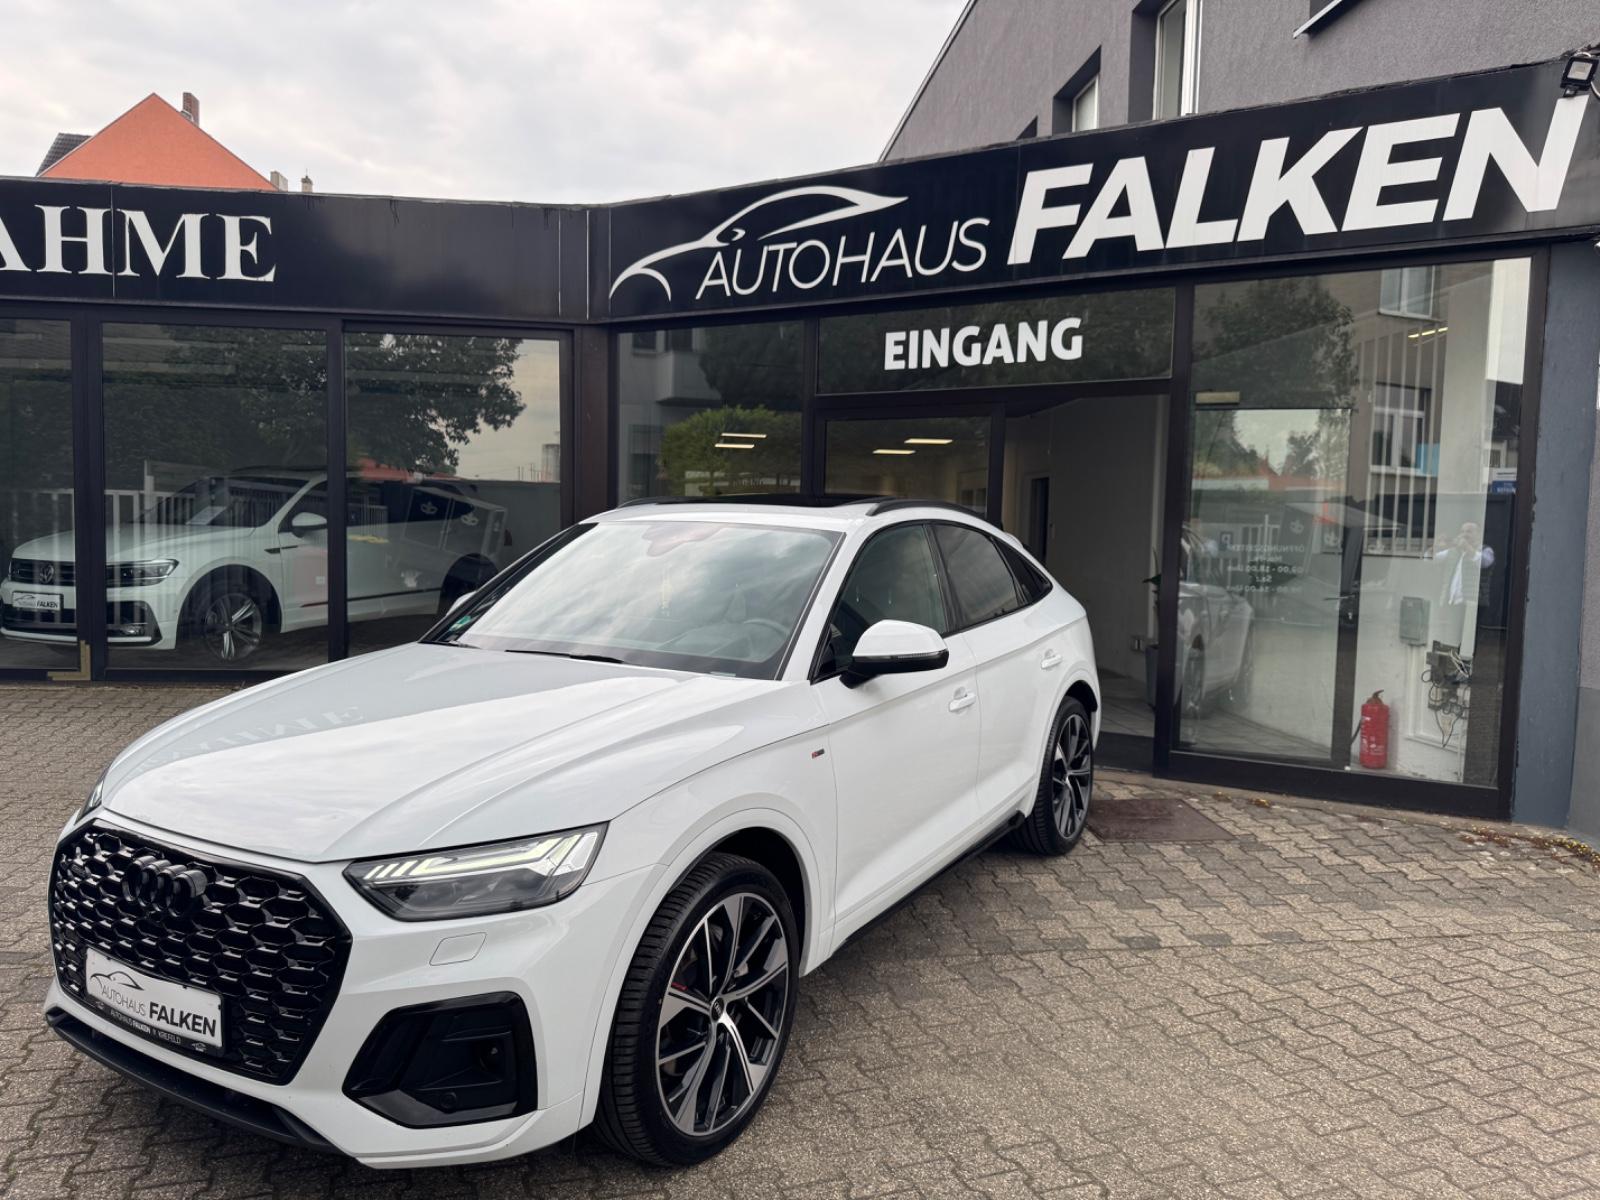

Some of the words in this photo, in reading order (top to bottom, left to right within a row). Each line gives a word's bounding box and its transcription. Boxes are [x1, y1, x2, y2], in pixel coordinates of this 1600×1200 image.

[695, 217, 990, 300] AUTOHAUS
[1007, 95, 1589, 265] FALKEN
[884, 317, 1083, 370] EINGANG
[101, 984, 146, 1017] AUTOHAUS
[149, 1001, 217, 1038] FALKEN
